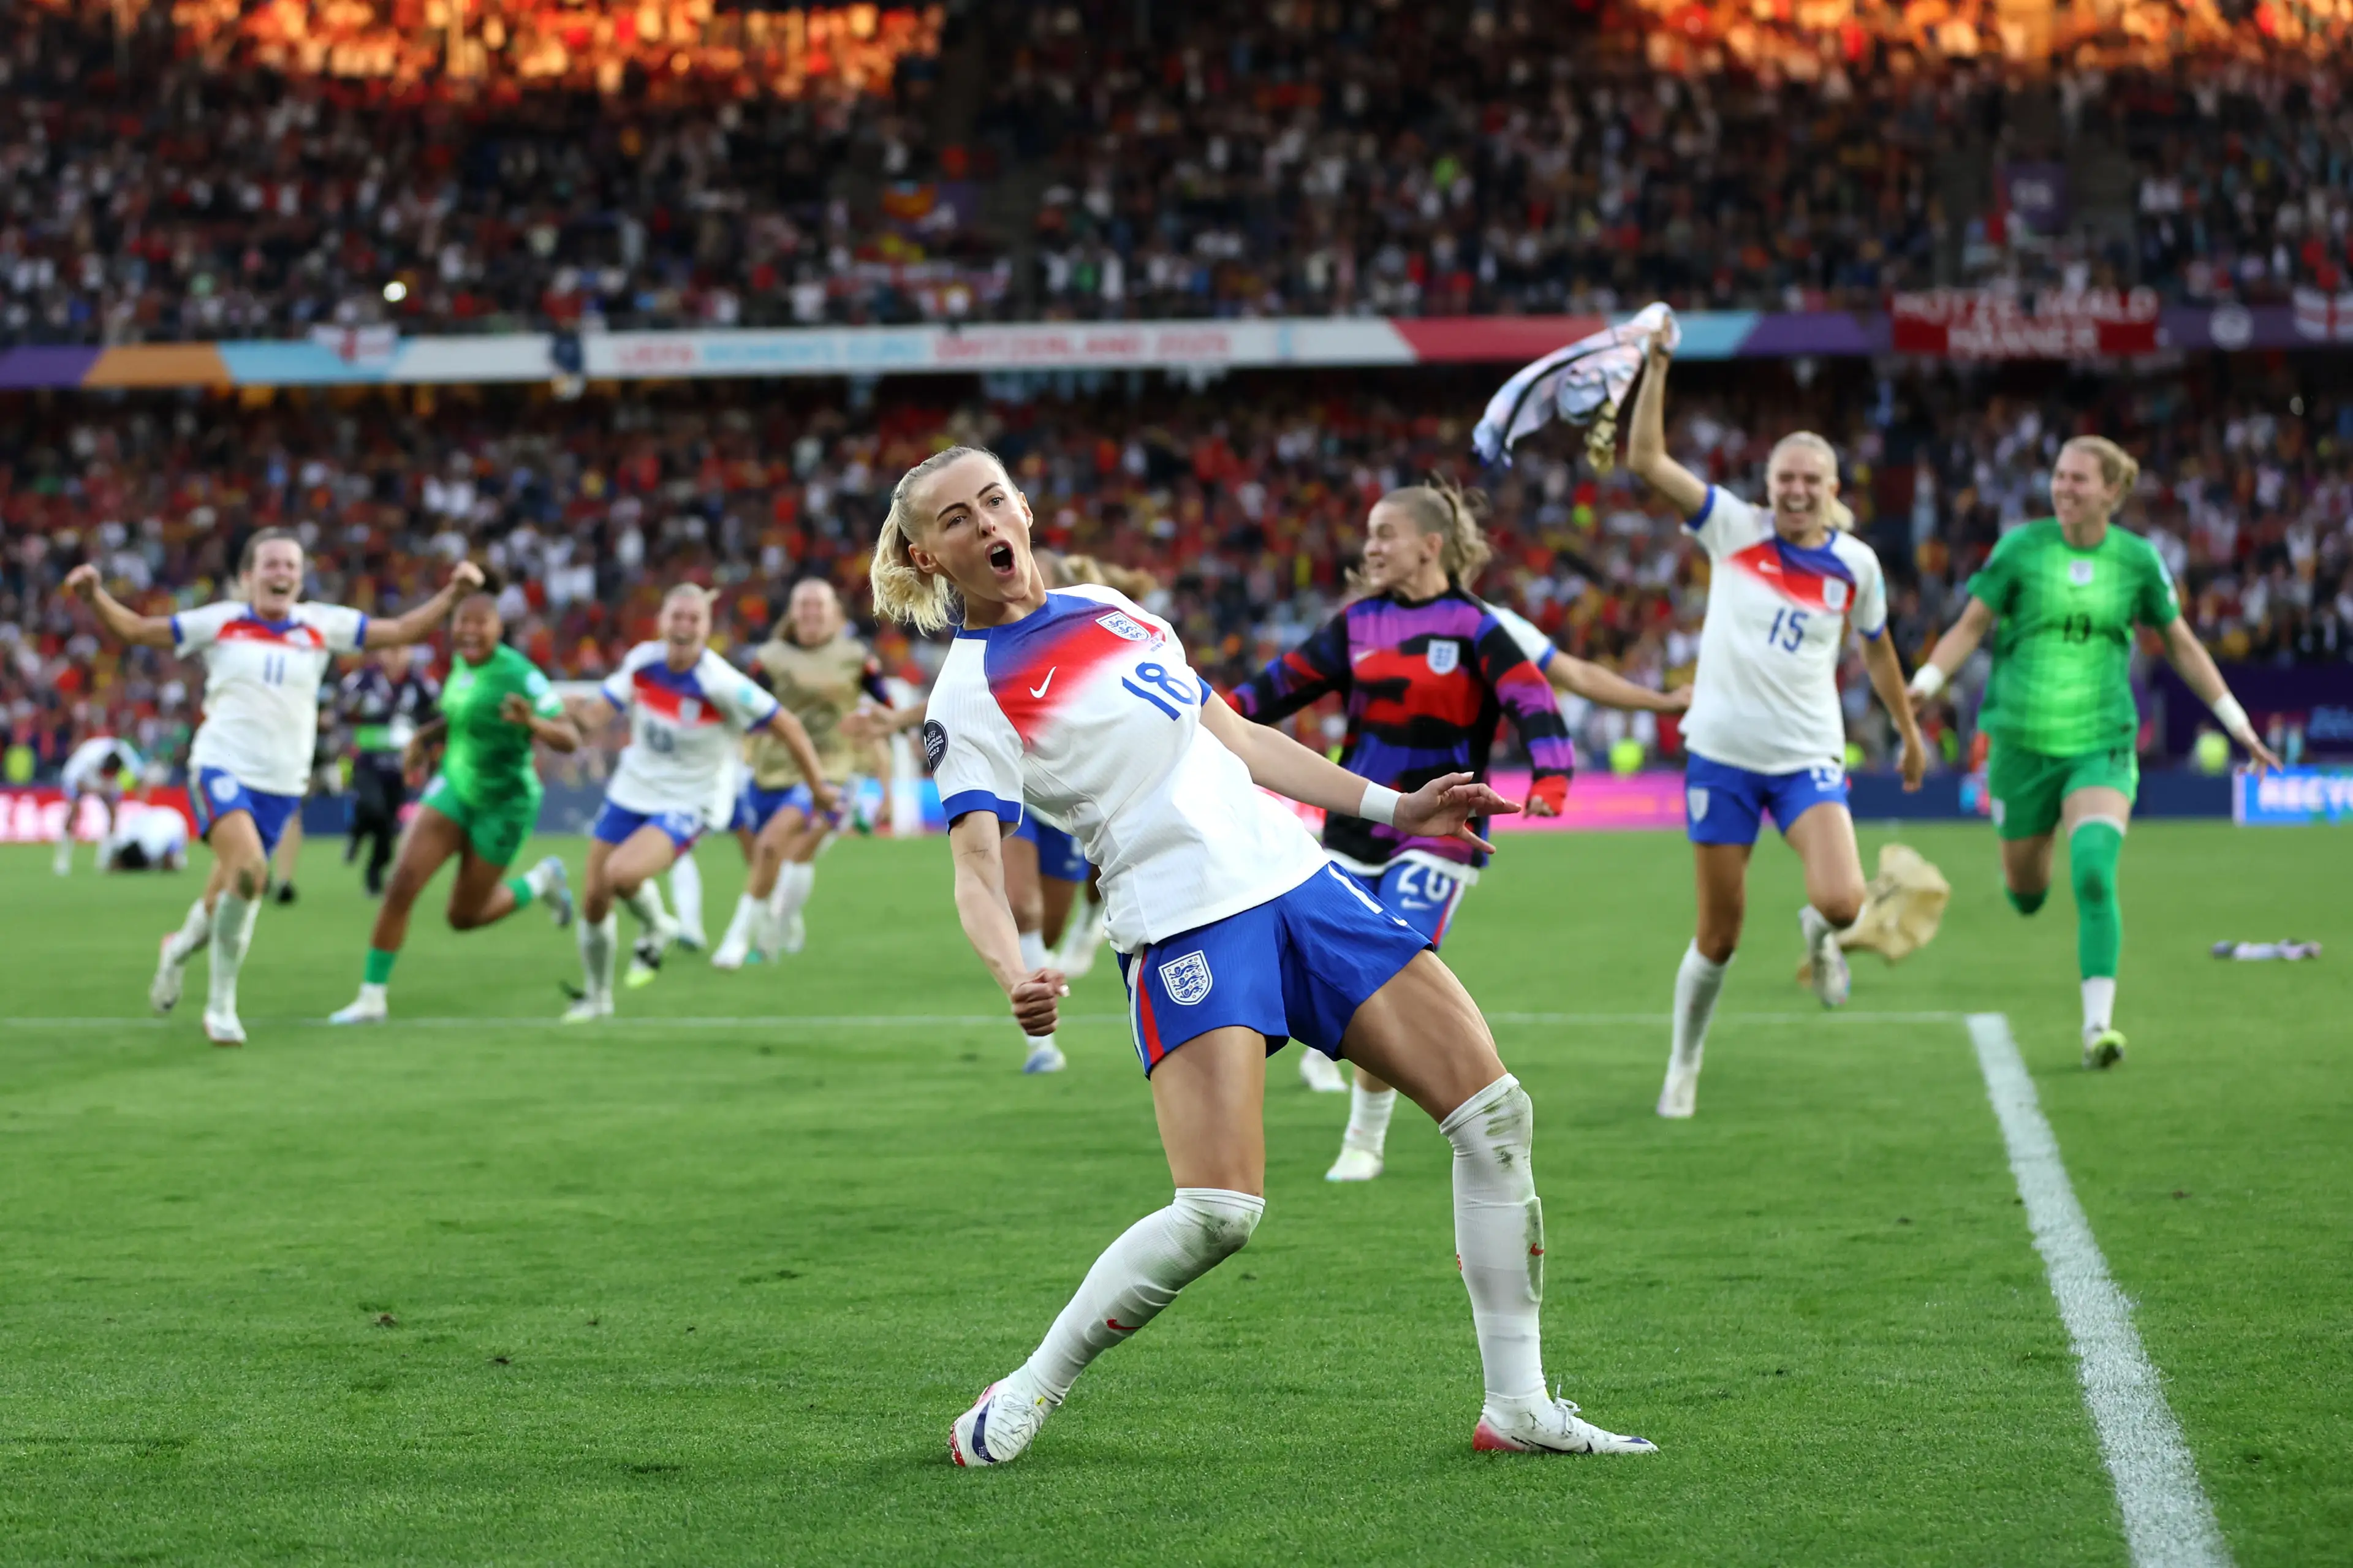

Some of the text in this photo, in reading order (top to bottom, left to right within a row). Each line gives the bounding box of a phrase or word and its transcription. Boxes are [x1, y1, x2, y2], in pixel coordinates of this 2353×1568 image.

[1768, 607, 1808, 653] 15
[263, 653, 286, 686] 11
[1122, 661, 1197, 721] 18
